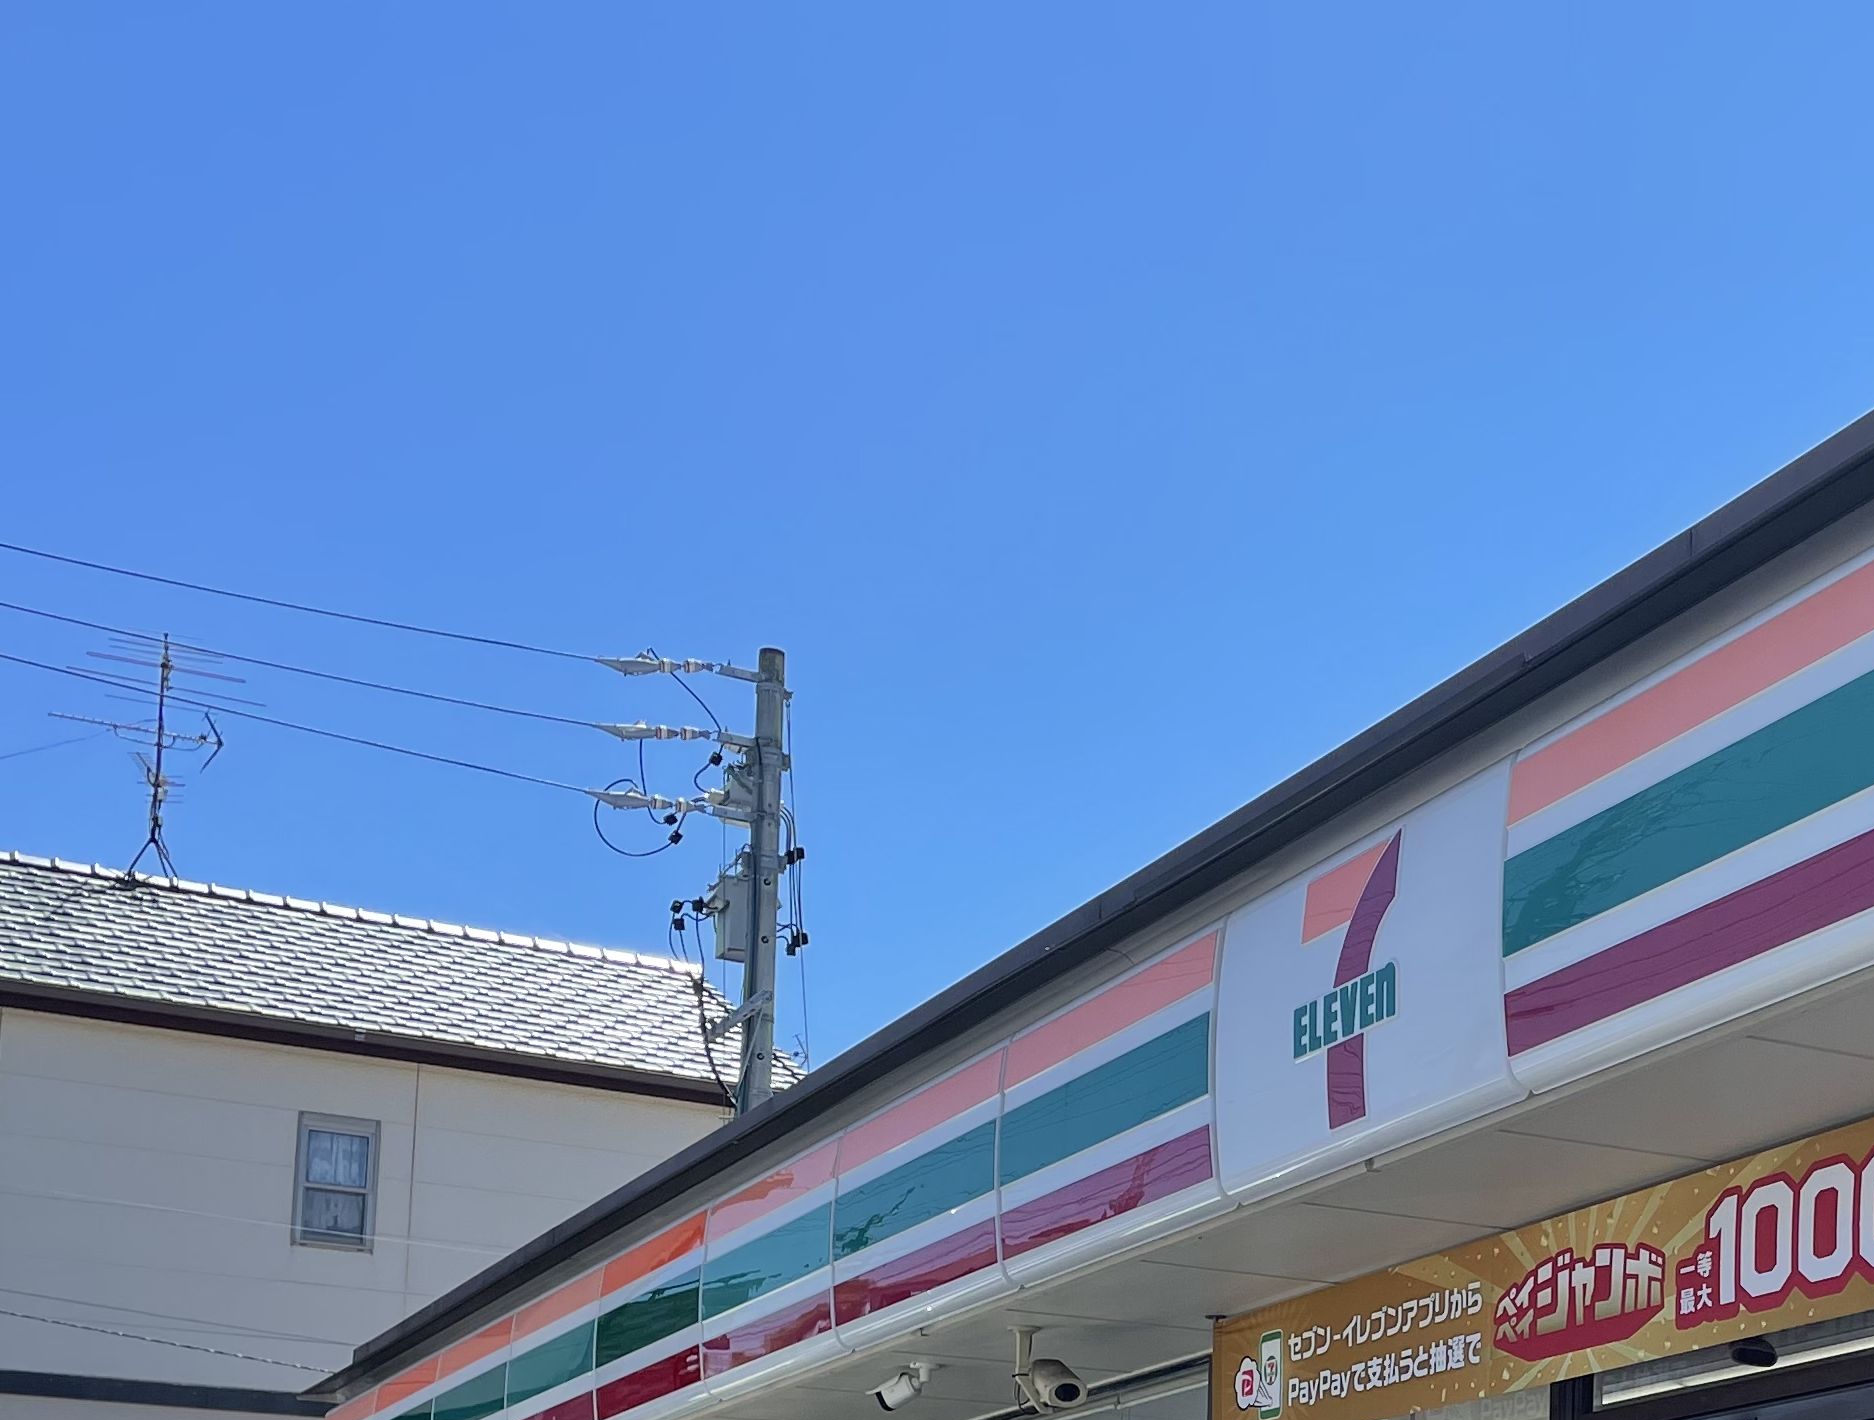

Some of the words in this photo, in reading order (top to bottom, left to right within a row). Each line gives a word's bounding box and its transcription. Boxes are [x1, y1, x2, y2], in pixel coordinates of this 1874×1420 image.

[1680, 1286, 1713, 1316] 最大
[1288, 1333, 1482, 1407] PayPayで支払うと抽選で
